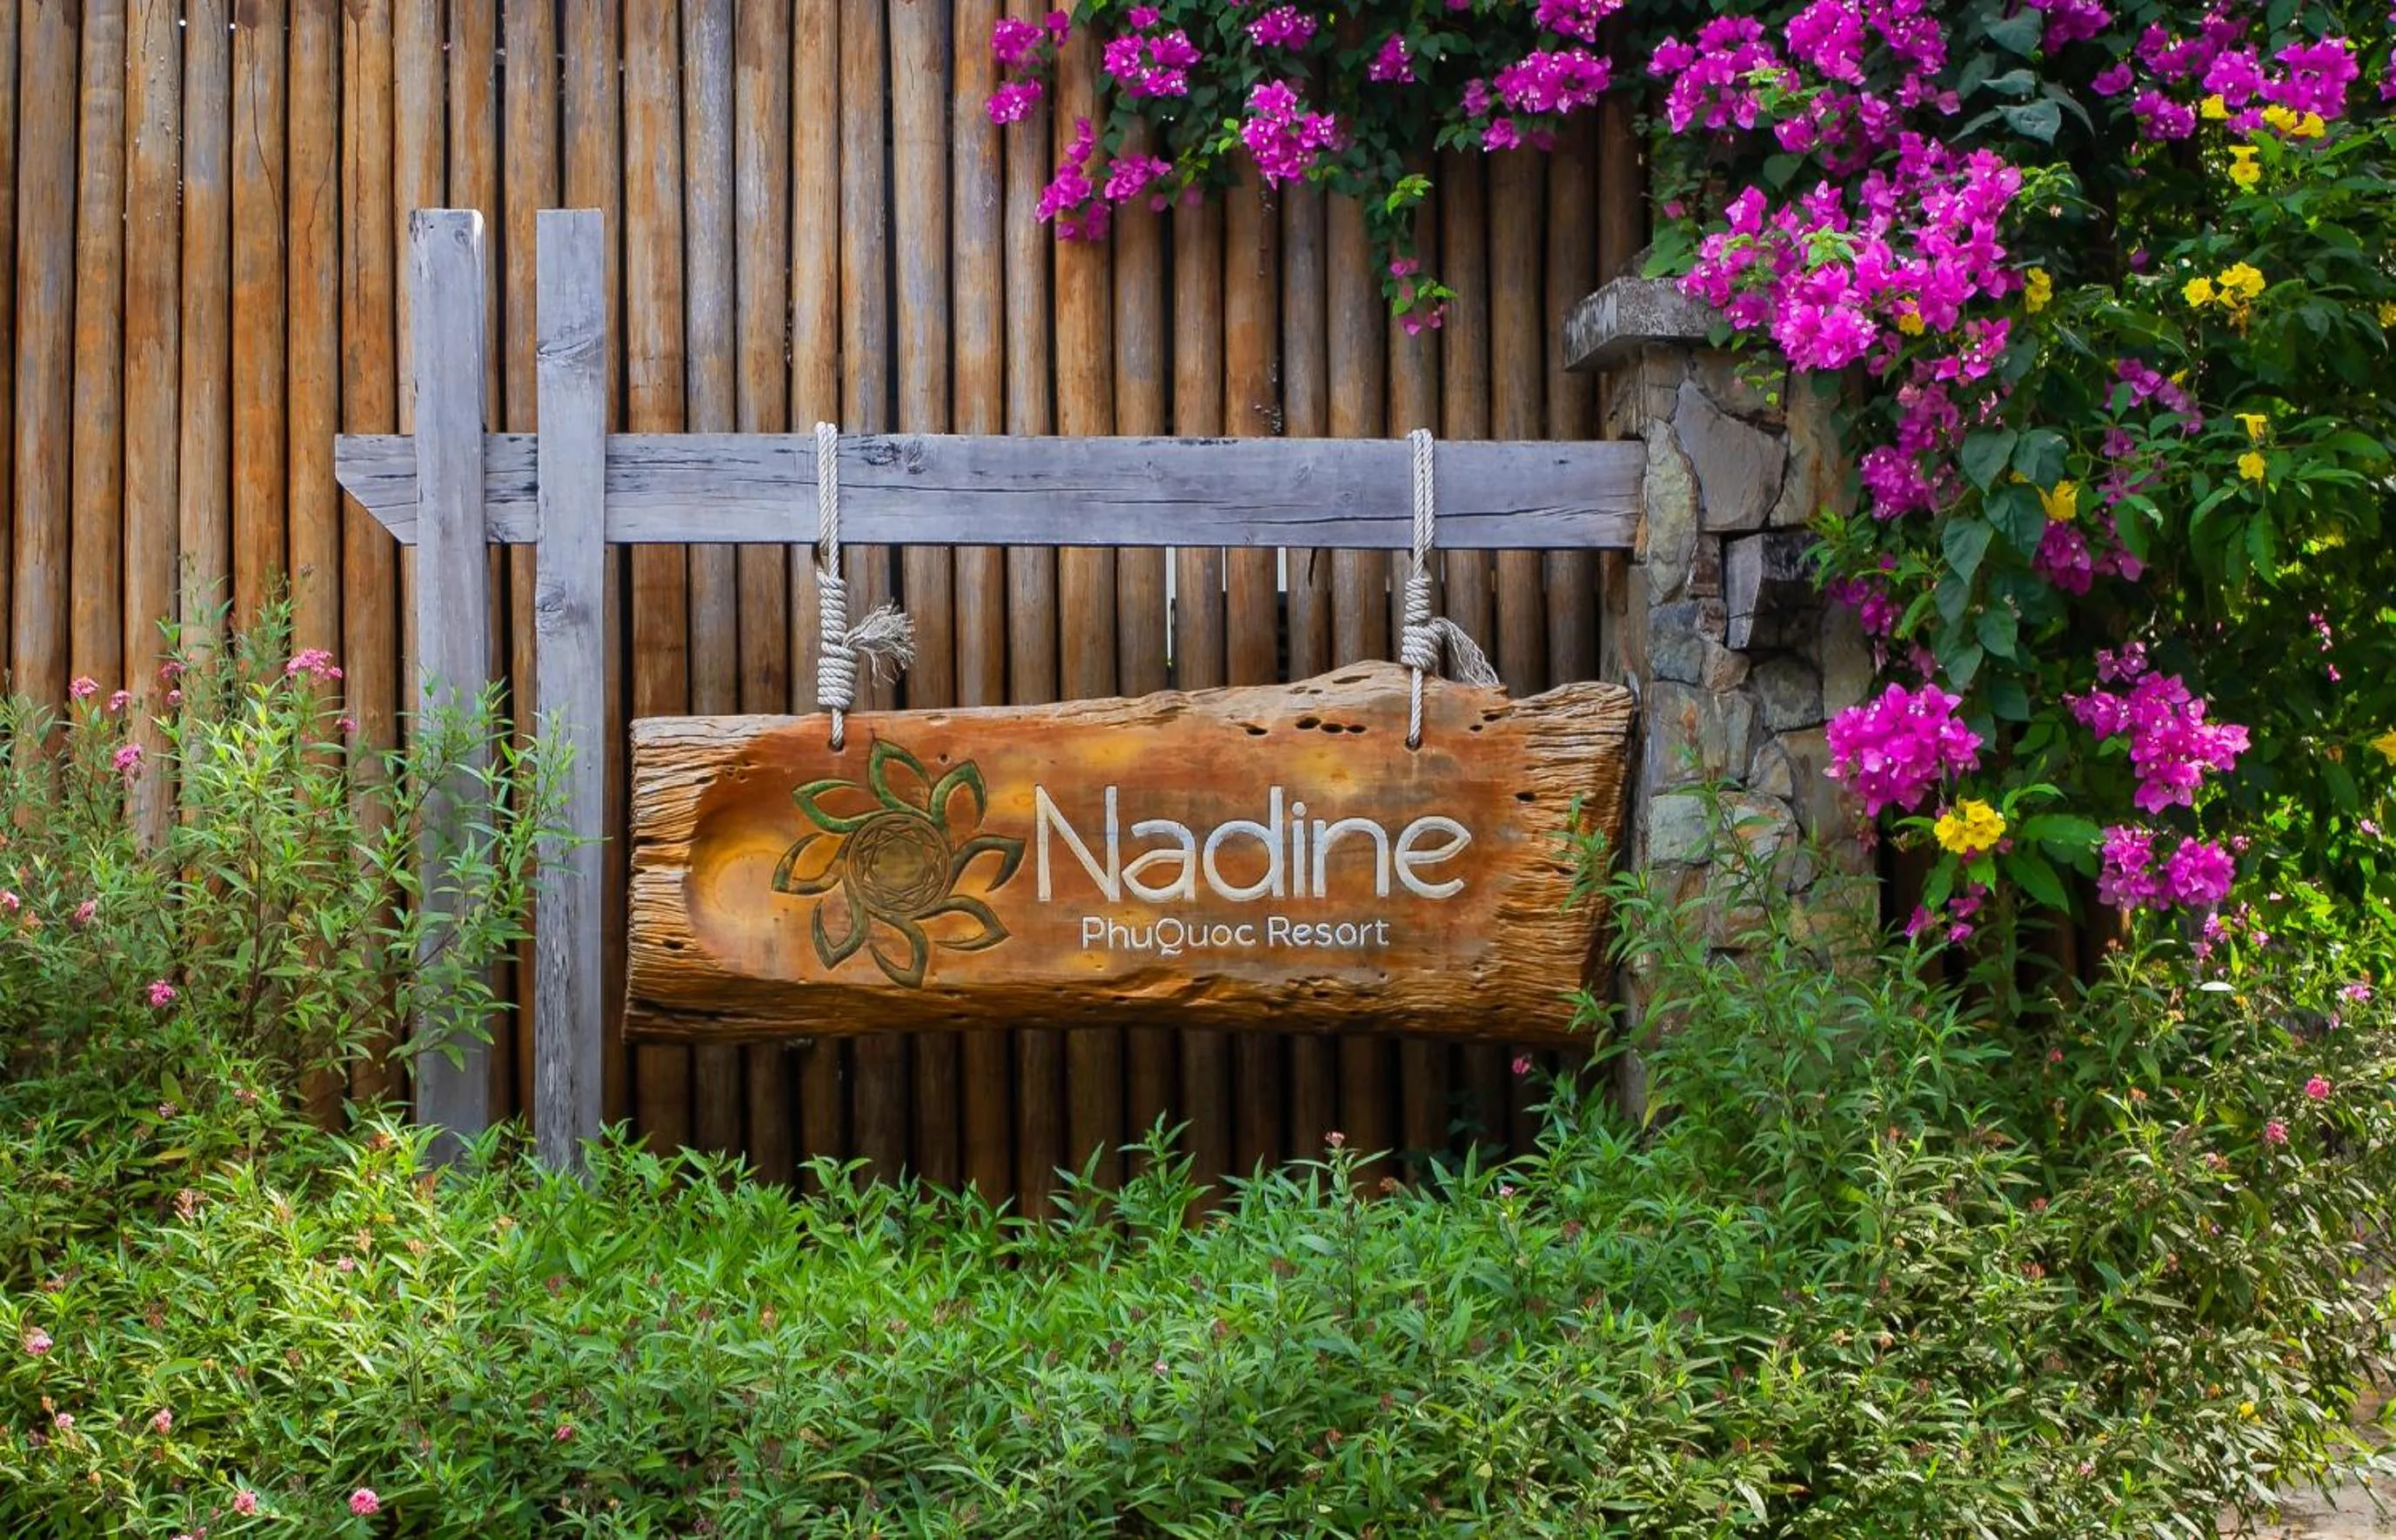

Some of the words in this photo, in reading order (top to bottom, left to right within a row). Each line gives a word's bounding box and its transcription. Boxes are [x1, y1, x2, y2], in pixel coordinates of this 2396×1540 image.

[1034, 785, 1472, 903] Nadine
[1081, 916, 1256, 955] PhuQuoc
[1268, 916, 1390, 949] Resort
